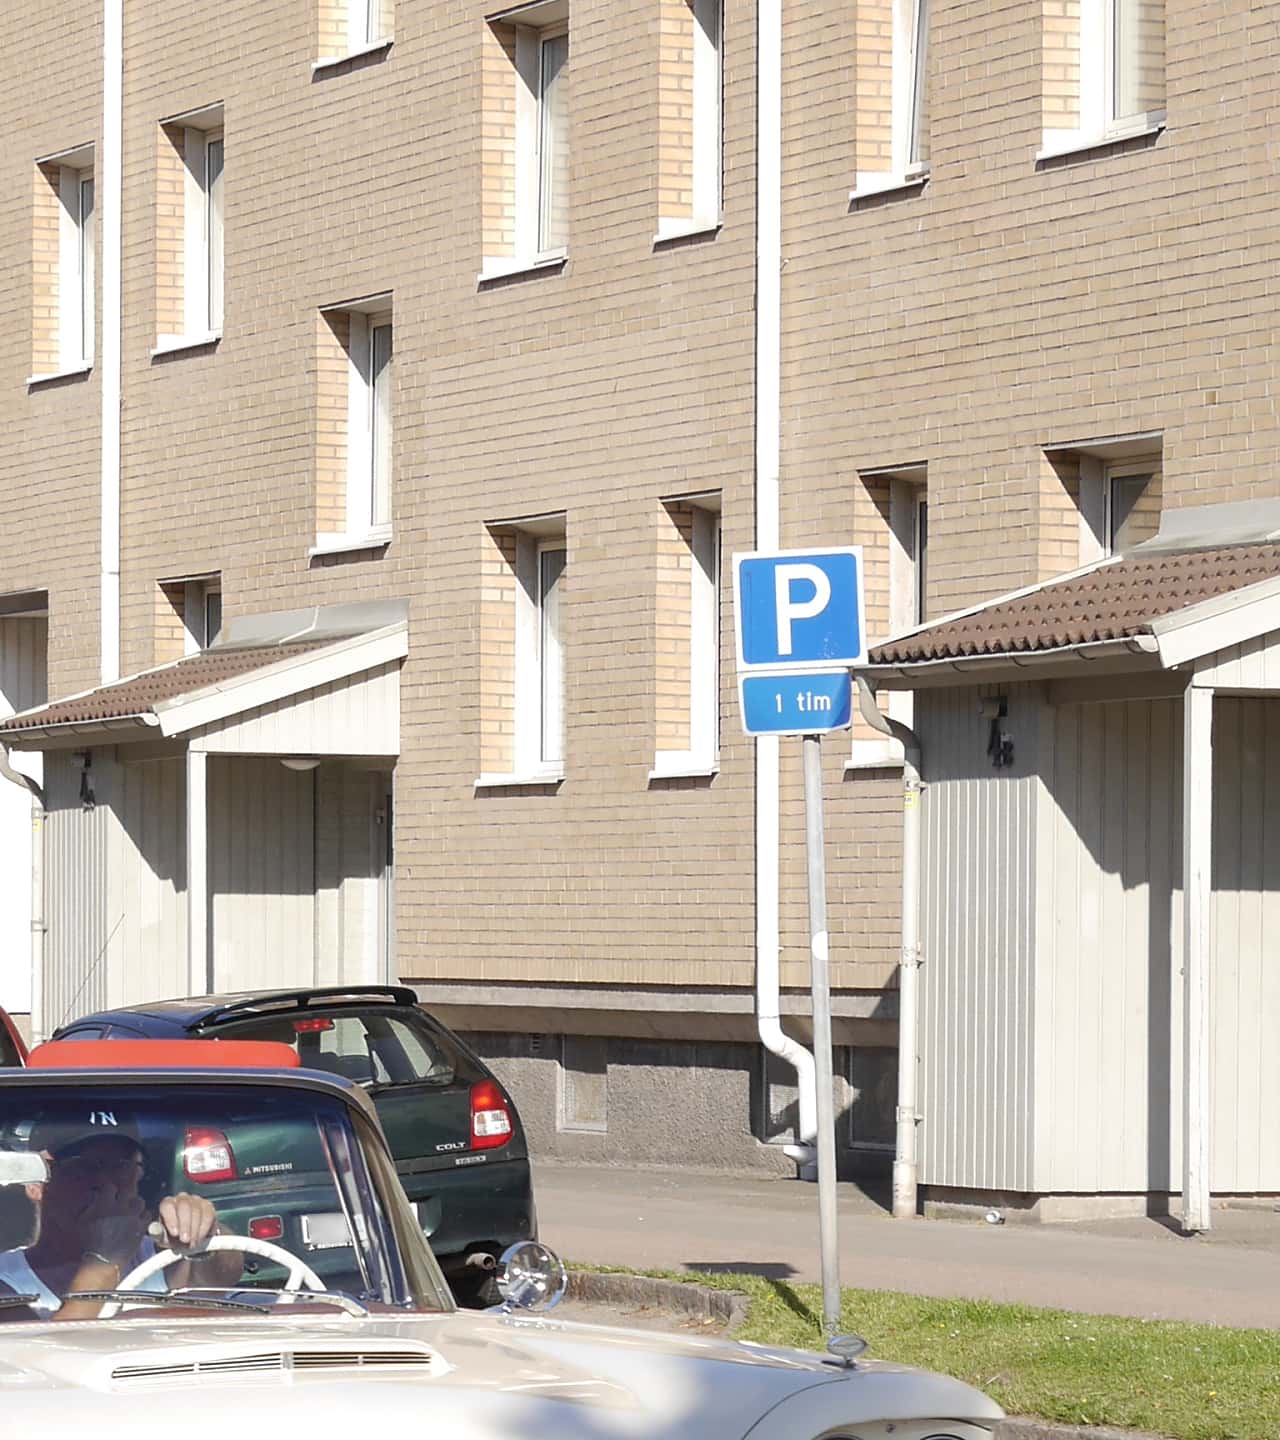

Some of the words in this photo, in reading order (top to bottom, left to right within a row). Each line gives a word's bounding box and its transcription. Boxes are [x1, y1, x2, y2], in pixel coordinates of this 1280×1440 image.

[774, 563, 832, 656] P
[775, 694, 782, 713] 1
[796, 691, 831, 712] tim
[436, 1142, 466, 1151] COLT
